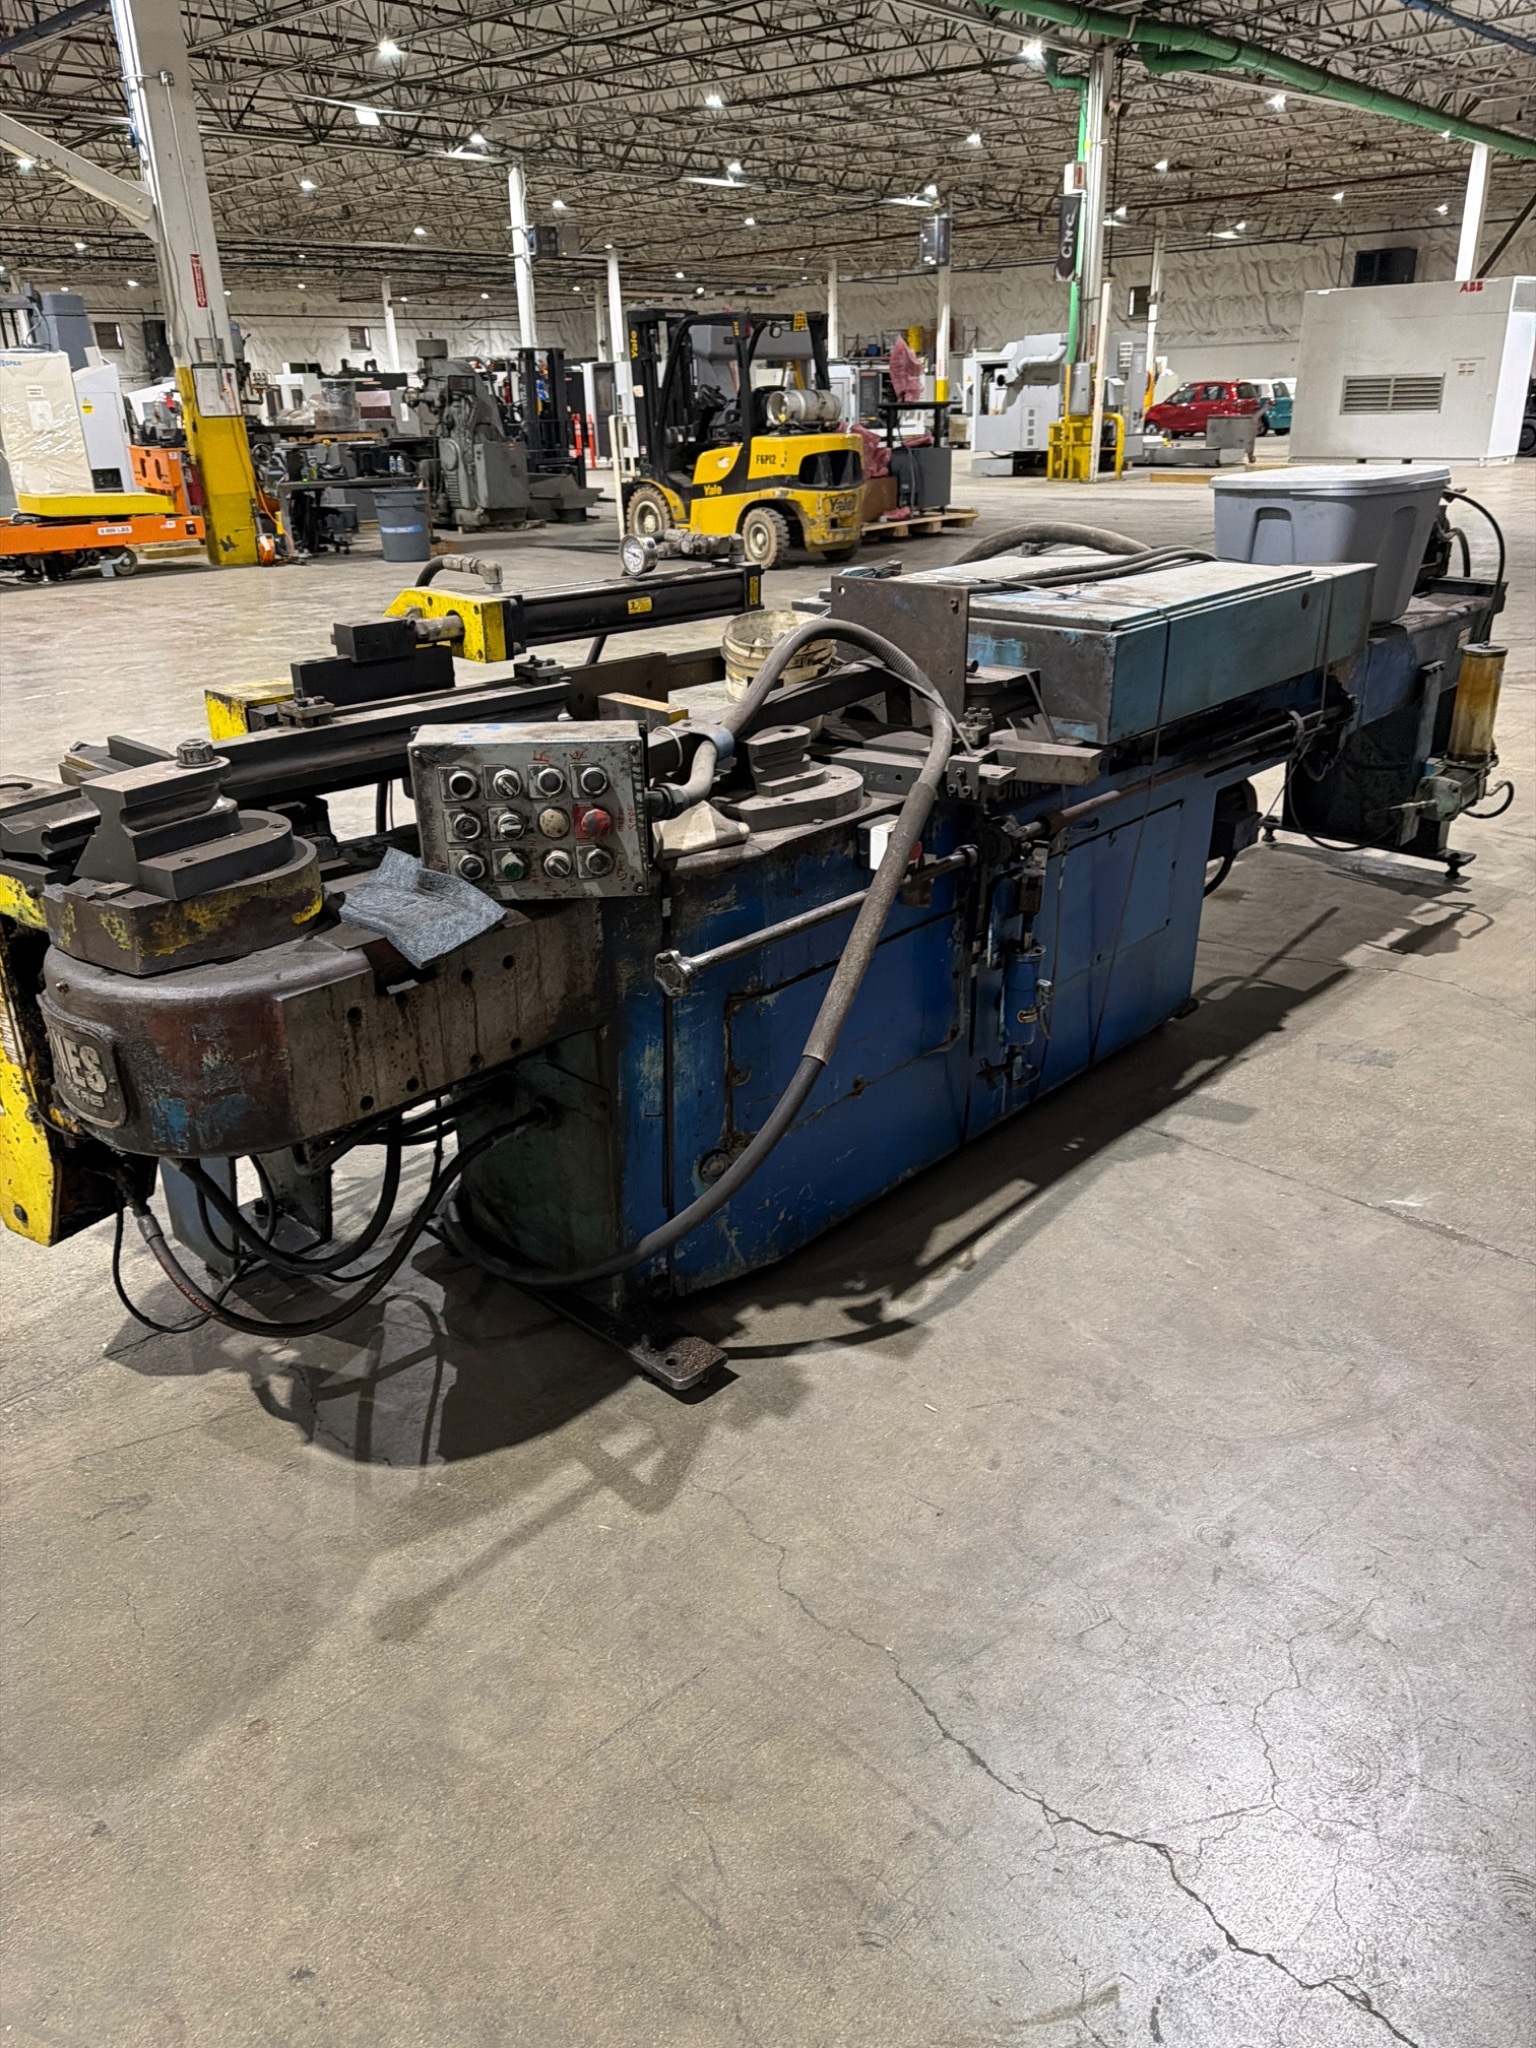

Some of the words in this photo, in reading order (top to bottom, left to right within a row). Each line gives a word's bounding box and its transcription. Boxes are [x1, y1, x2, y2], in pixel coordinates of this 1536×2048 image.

[1061, 208, 1077, 259] CNC
[1459, 281, 1484, 293] ABB
[630, 330, 639, 359] Yale
[703, 484, 723, 497] Yale
